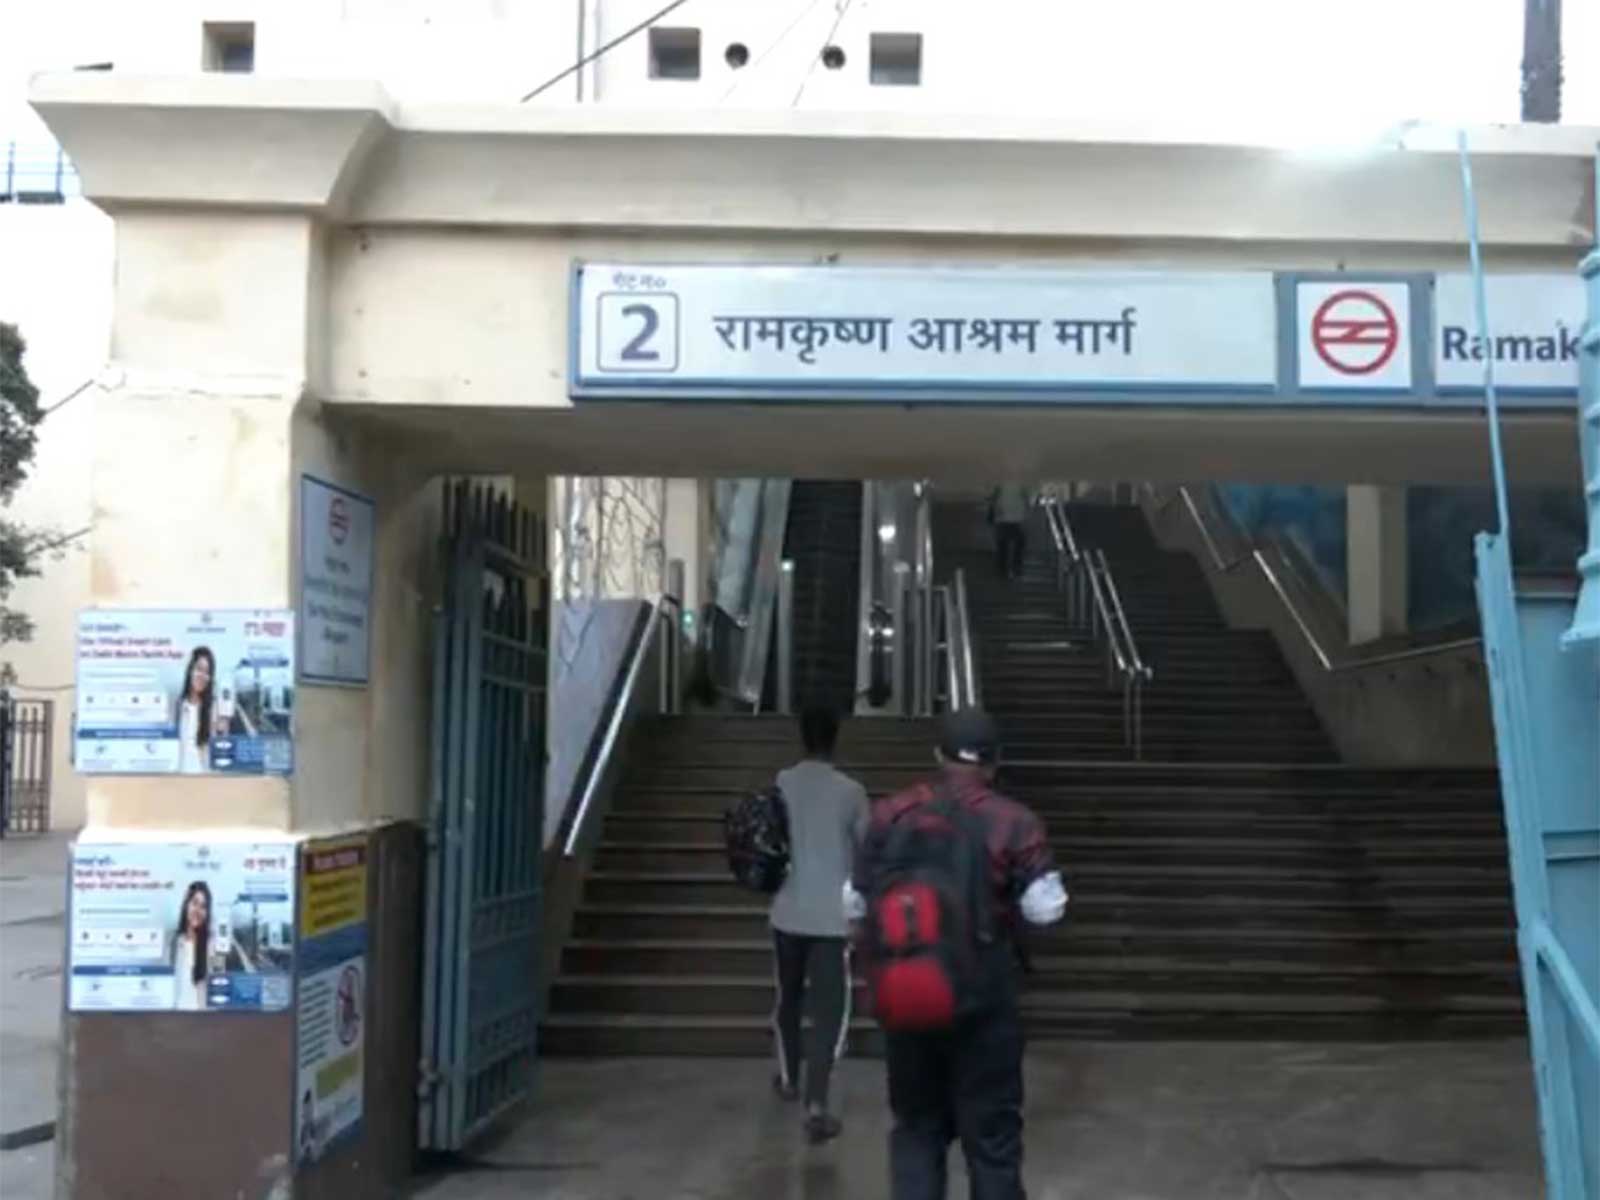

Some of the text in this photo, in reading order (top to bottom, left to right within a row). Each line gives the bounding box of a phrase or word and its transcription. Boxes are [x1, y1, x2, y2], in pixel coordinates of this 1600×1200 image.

[621, 303, 660, 361] 2
[713, 307, 1137, 364] रामकृष्ण आश्रम मार्ग
